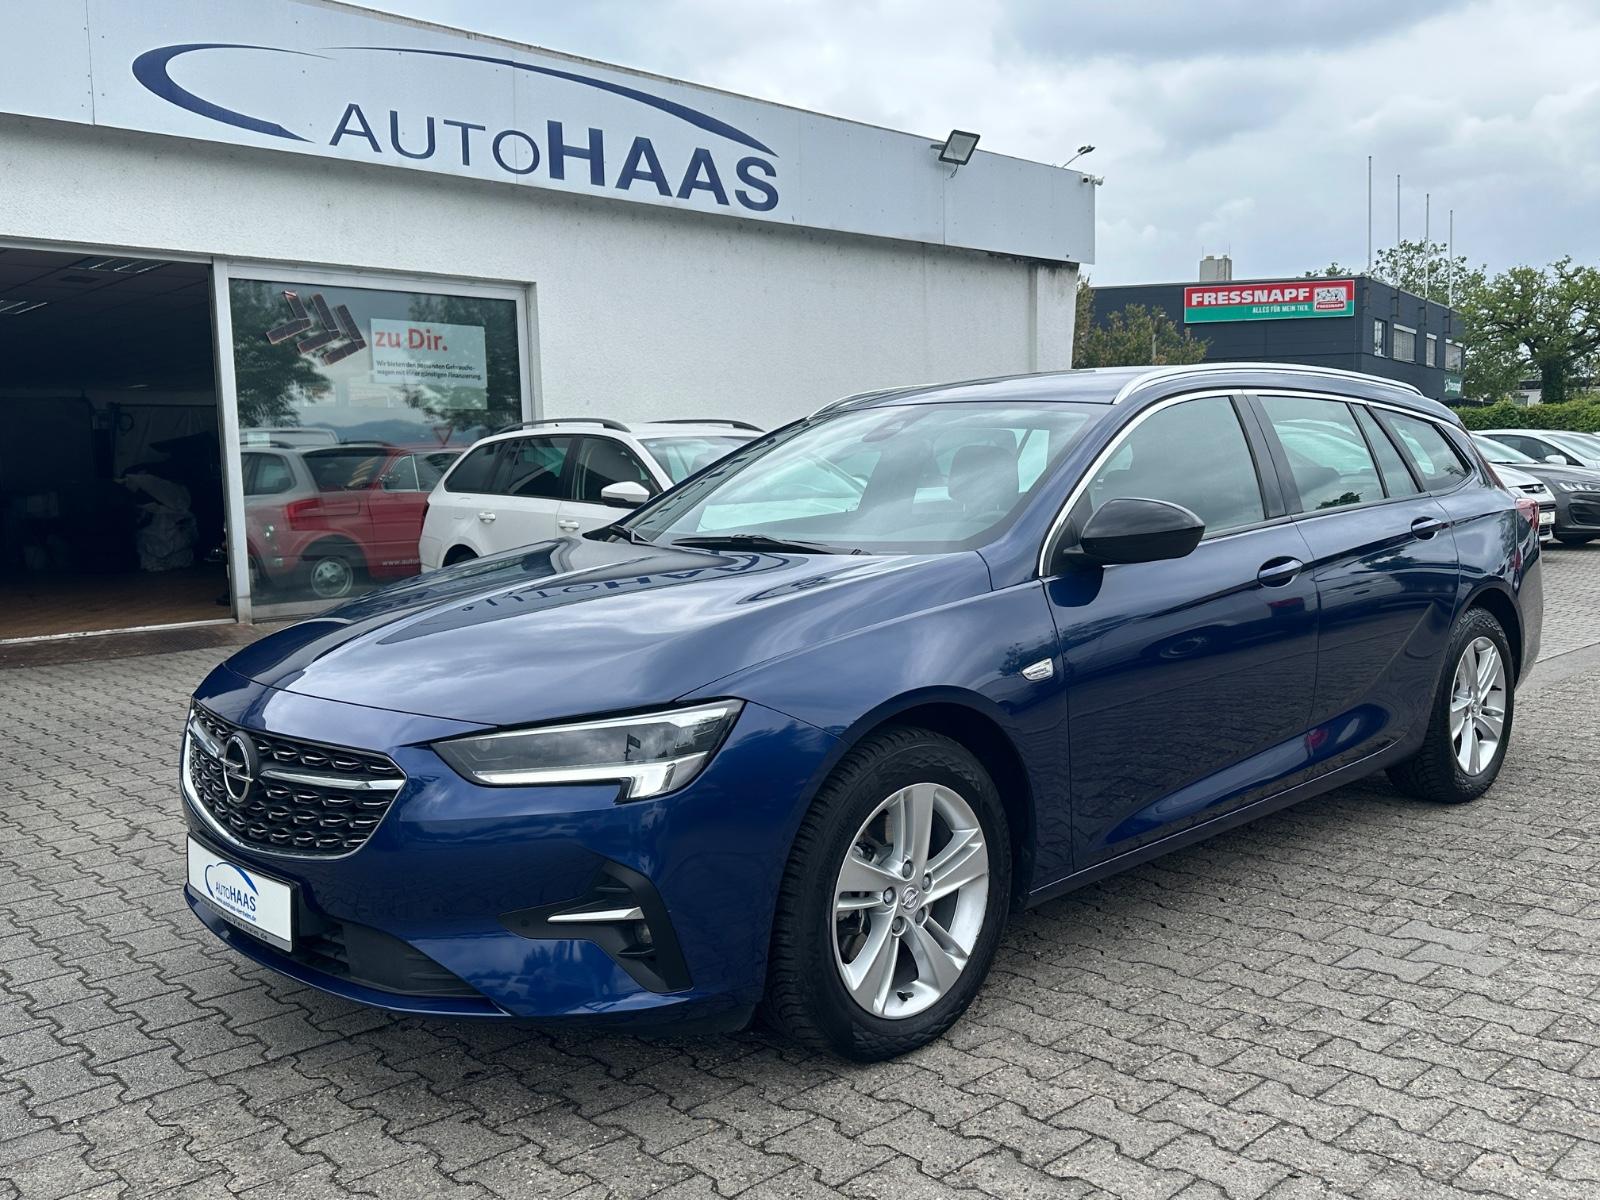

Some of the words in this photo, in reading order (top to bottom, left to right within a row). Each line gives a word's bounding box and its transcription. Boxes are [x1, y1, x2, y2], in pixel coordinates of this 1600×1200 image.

[328, 102, 780, 212] AUTOHAAS
[1191, 287, 1310, 305] FRESSNAPF
[1252, 306, 1270, 314] ALLES
[1271, 305, 1281, 313] FÜR
[1281, 304, 1296, 312] MEIN
[374, 331, 401, 348] zu
[407, 328, 448, 351] Dir.
[420, 371, 447, 379] günstigen
[215, 881, 256, 912] AUTOHAAS
